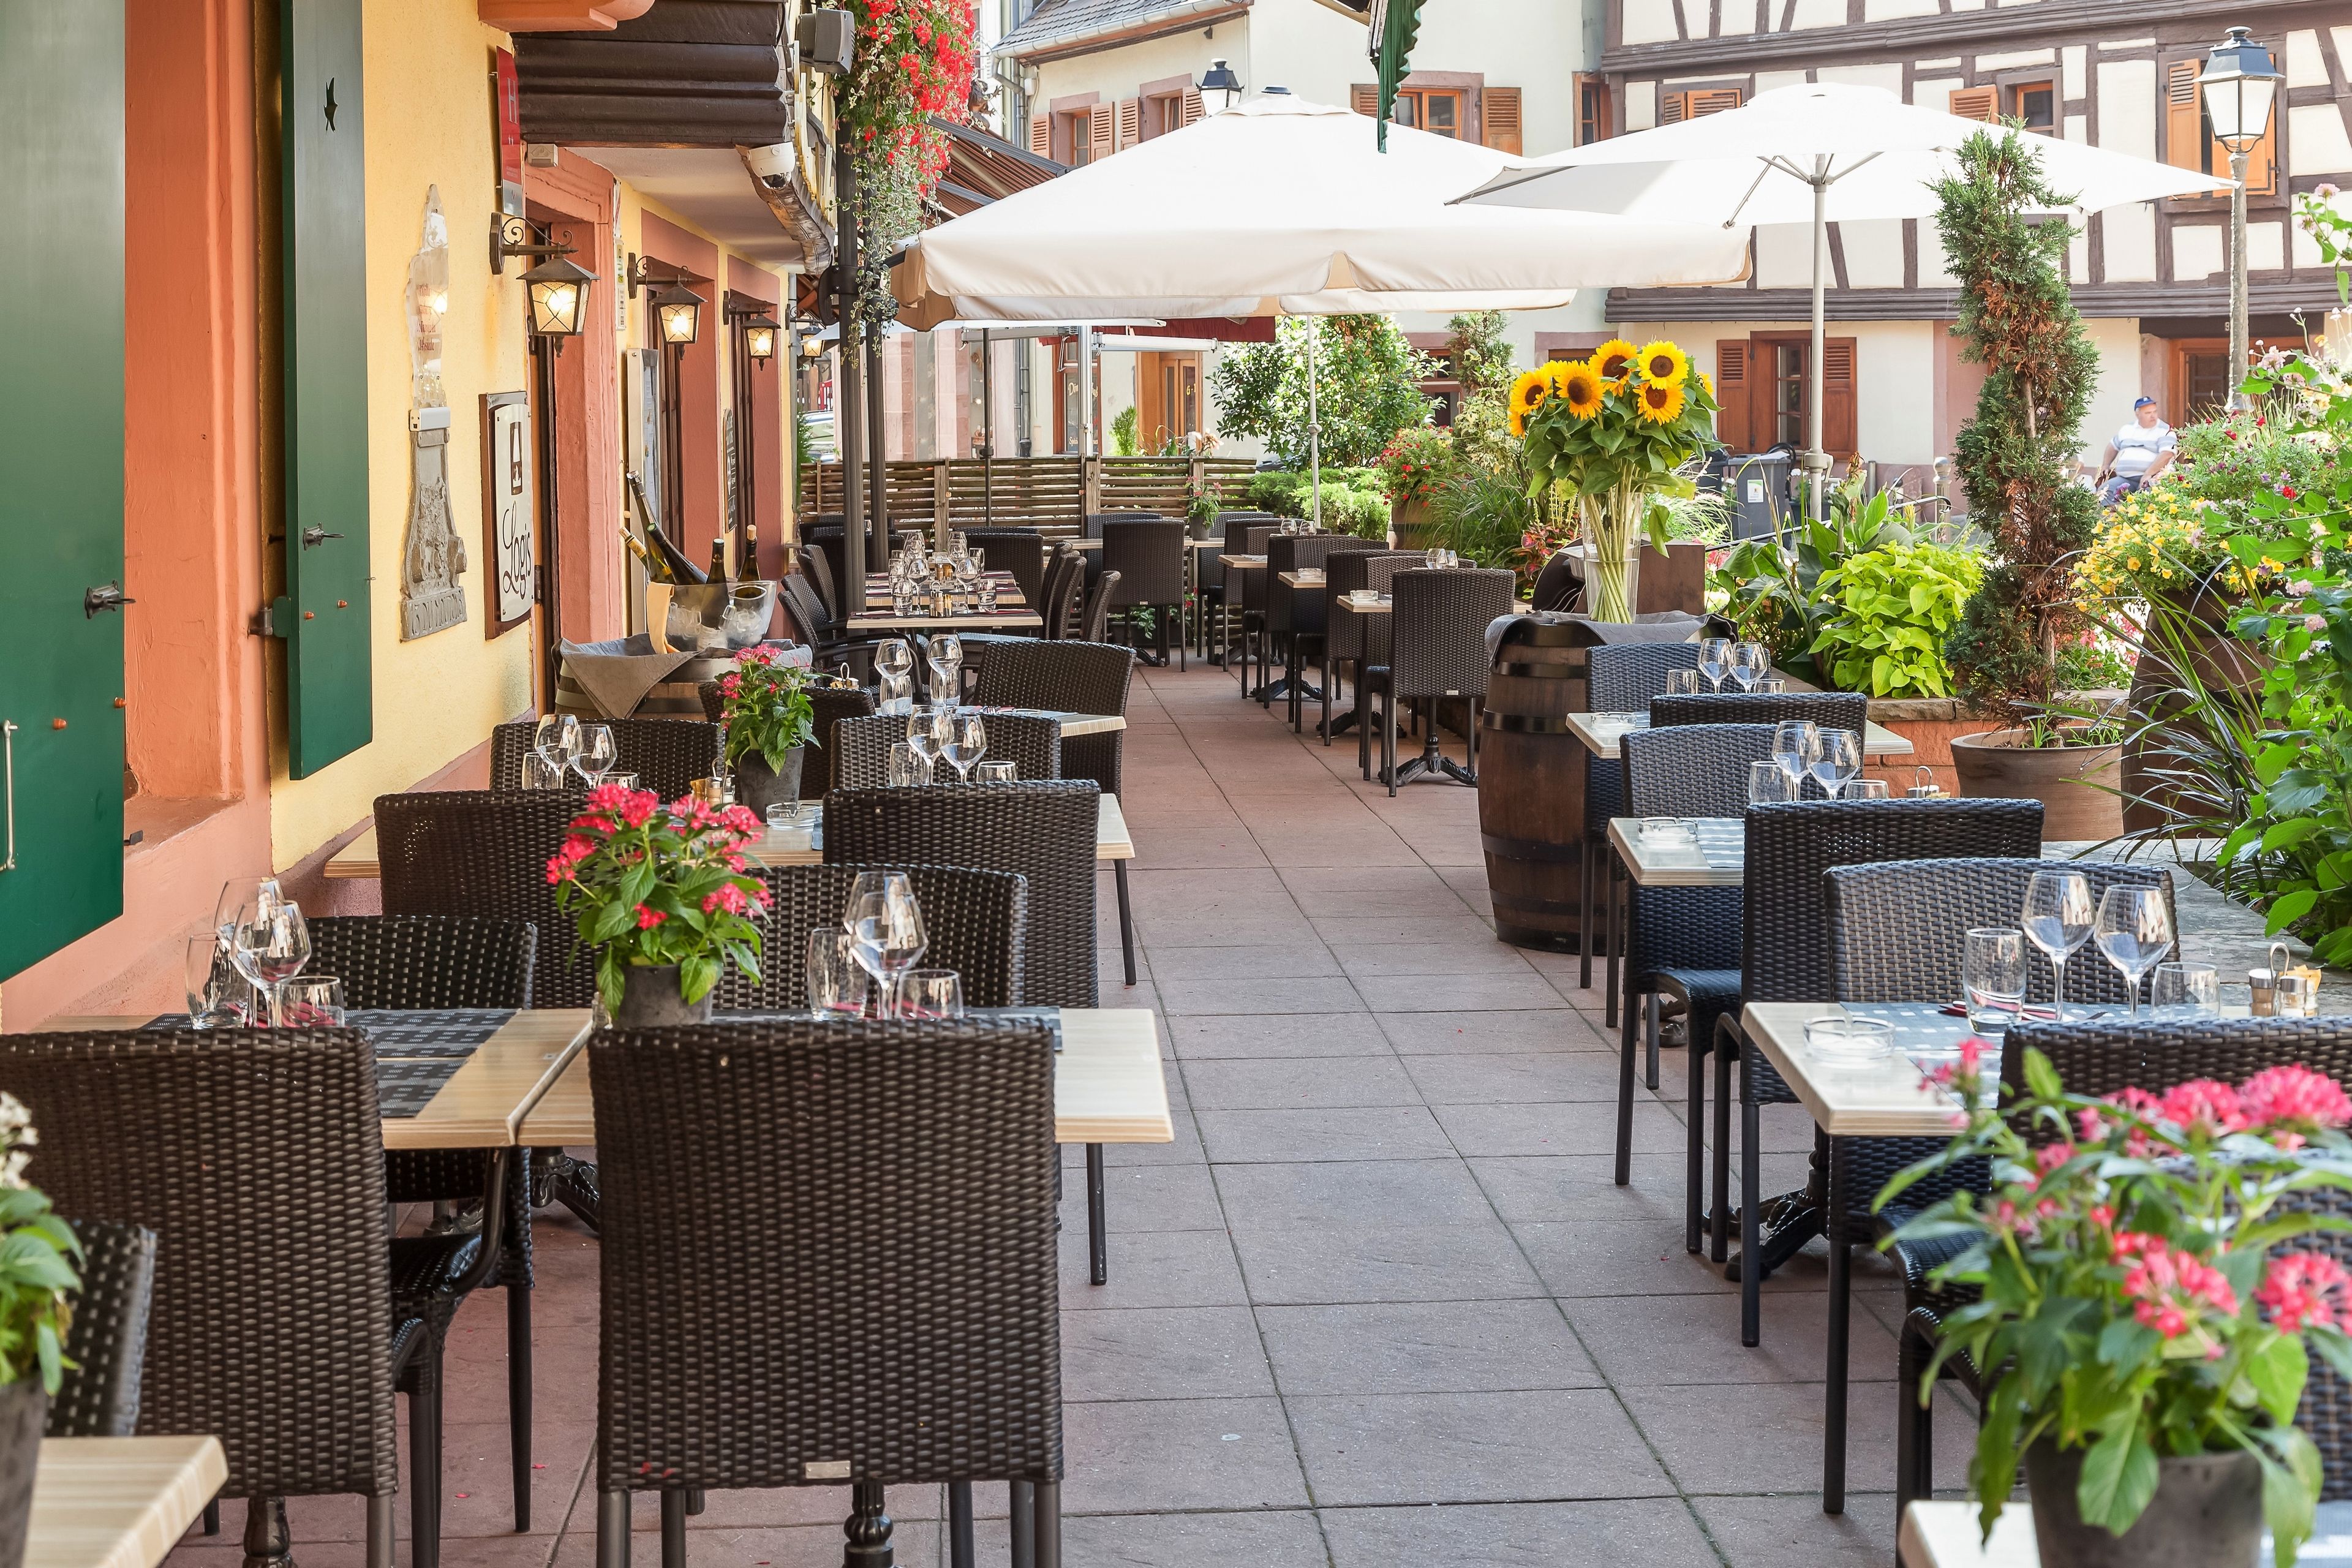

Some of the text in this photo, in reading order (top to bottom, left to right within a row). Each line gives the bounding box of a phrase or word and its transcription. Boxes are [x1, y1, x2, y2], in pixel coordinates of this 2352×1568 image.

[507, 77, 518, 124] H
[2225, 321, 2230, 332] 9
[502, 500, 532, 600] Logis
